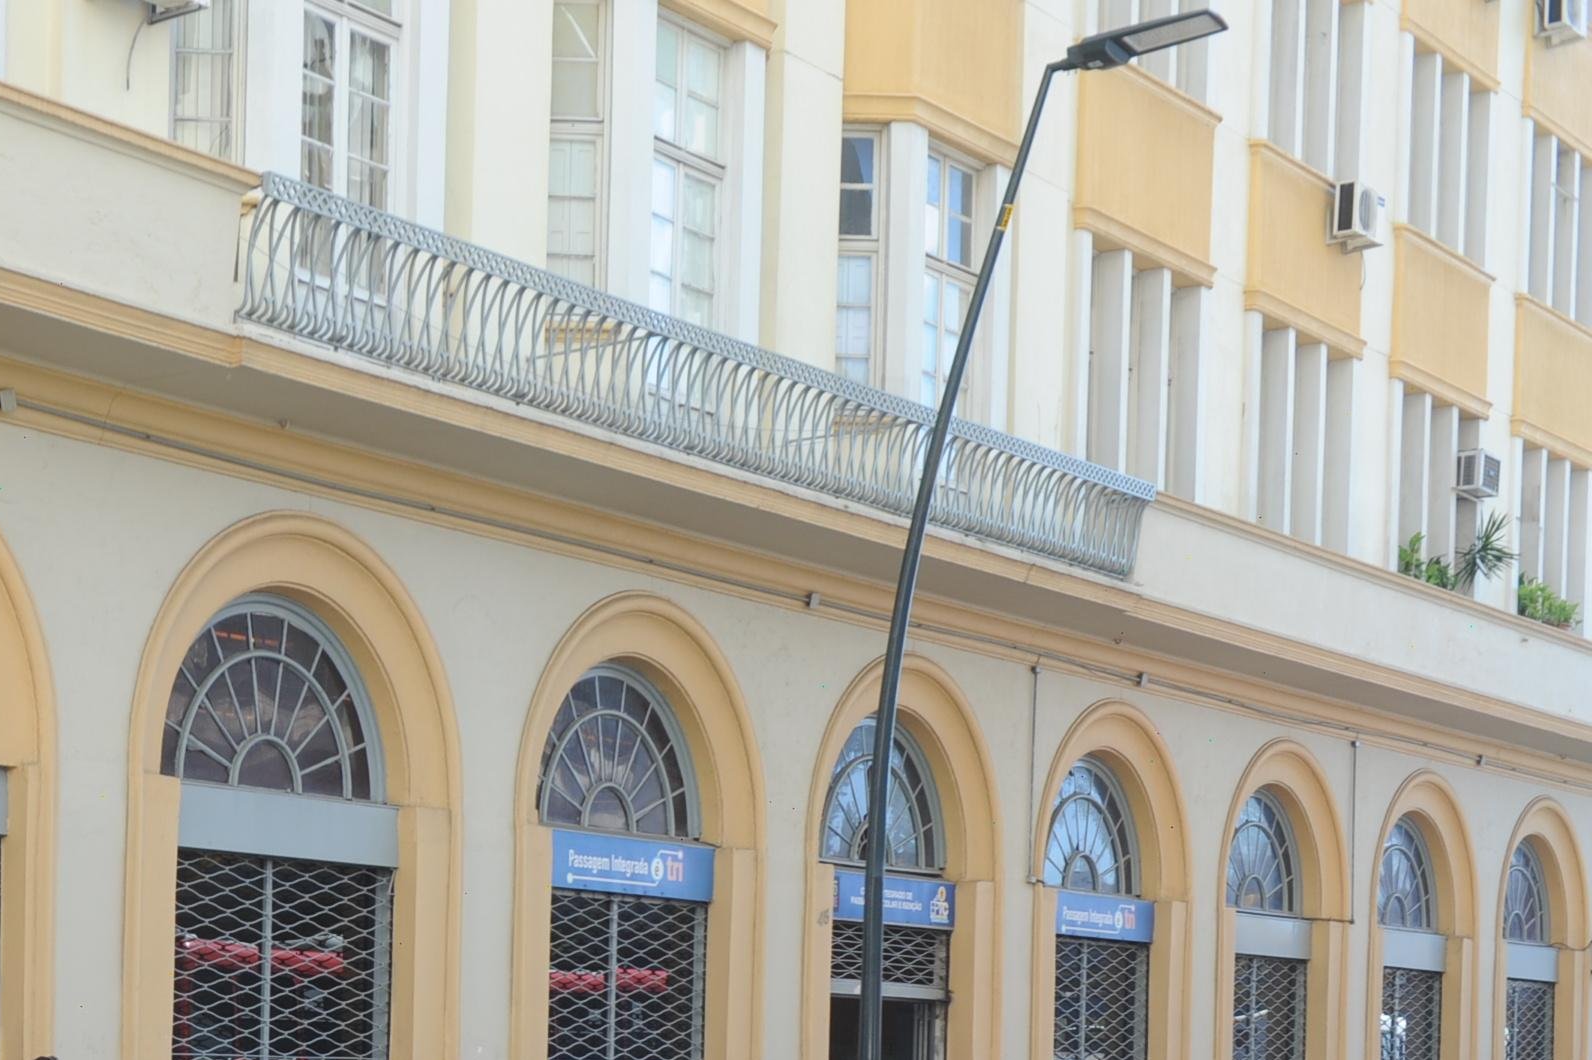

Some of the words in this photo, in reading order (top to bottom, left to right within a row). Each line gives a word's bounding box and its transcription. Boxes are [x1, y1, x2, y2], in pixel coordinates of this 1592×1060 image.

[568, 849, 610, 873] Passagem
[611, 855, 648, 877] Integrada
[666, 856, 683, 882] tri
